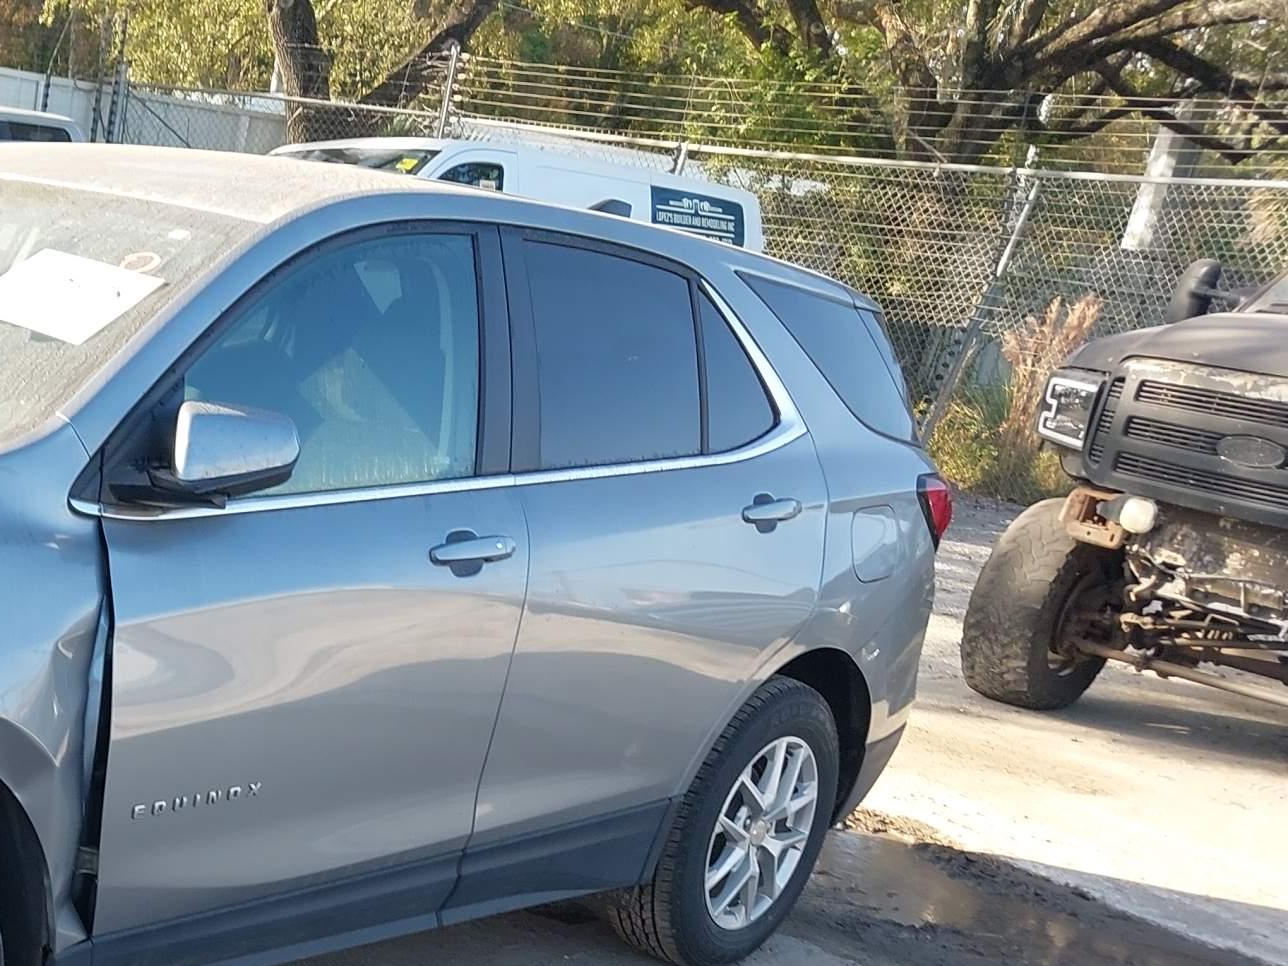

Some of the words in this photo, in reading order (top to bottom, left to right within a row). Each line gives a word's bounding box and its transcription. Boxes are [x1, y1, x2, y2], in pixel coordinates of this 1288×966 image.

[692, 216, 702, 228] AND
[702, 217, 728, 231] REMODELING
[131, 781, 262, 820] EQUINOX
